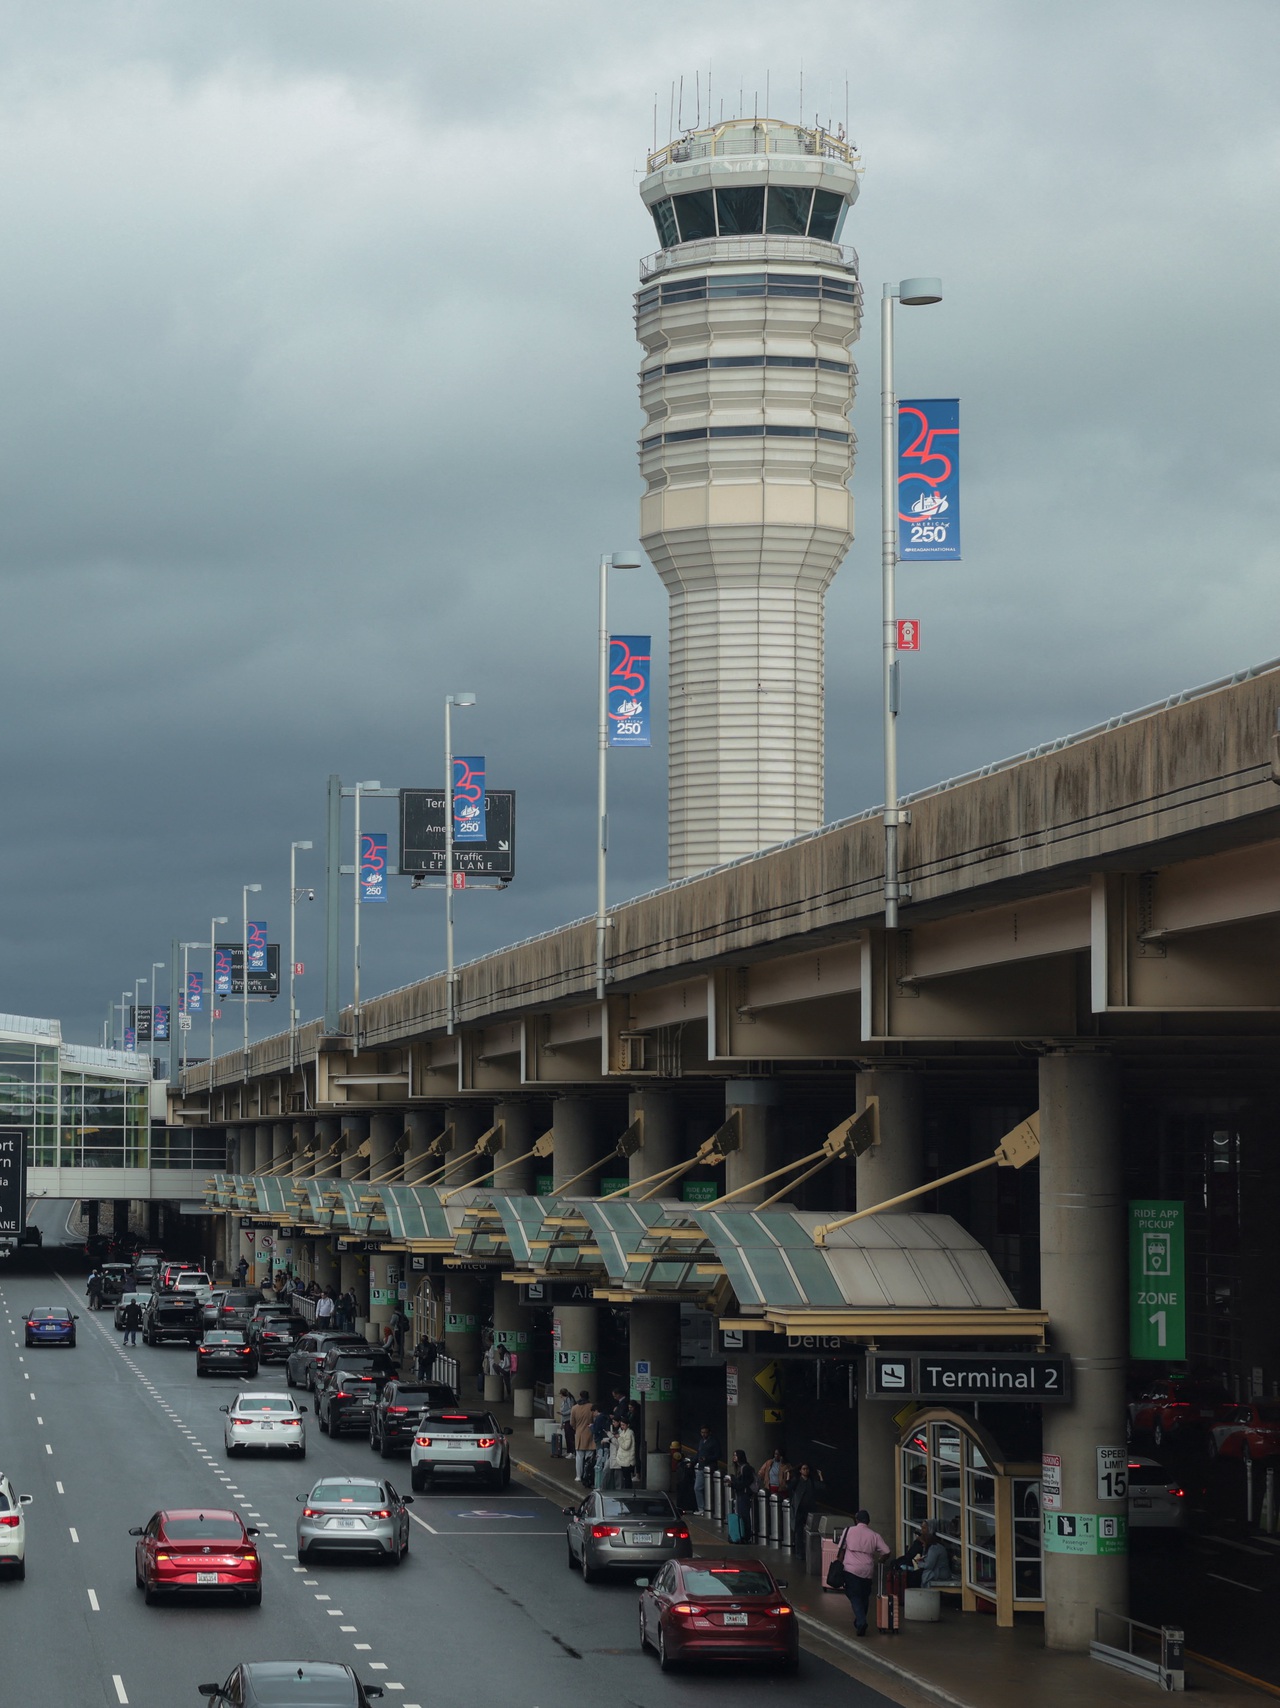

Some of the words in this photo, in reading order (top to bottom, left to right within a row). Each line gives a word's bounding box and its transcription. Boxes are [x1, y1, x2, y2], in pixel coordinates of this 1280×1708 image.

[910, 526, 947, 543] 250
[617, 723, 641, 734] 250
[460, 823, 479, 832] 250
[454, 852, 483, 861] Traffic
[421, 861, 443, 869] LEF
[460, 862, 493, 870] LANE
[366, 887, 382, 895] 250
[1133, 1209, 1158, 1218] RIDE
[1160, 1209, 1179, 1219] APP
[1138, 1220, 1175, 1229] PICKUP
[389, 1274, 399, 1283] 15
[1137, 1292, 1177, 1305] ZONE
[1148, 1310, 1167, 1347] 1
[787, 1336, 841, 1348] Delta
[926, 1367, 1035, 1388] Terminal
[1044, 1368, 1058, 1389] 2
[1100, 1449, 1125, 1458] SPEED
[1104, 1461, 1124, 1469] LIMIT
[1101, 1472, 1126, 1497] 15
[1083, 1522, 1089, 1533] 1
